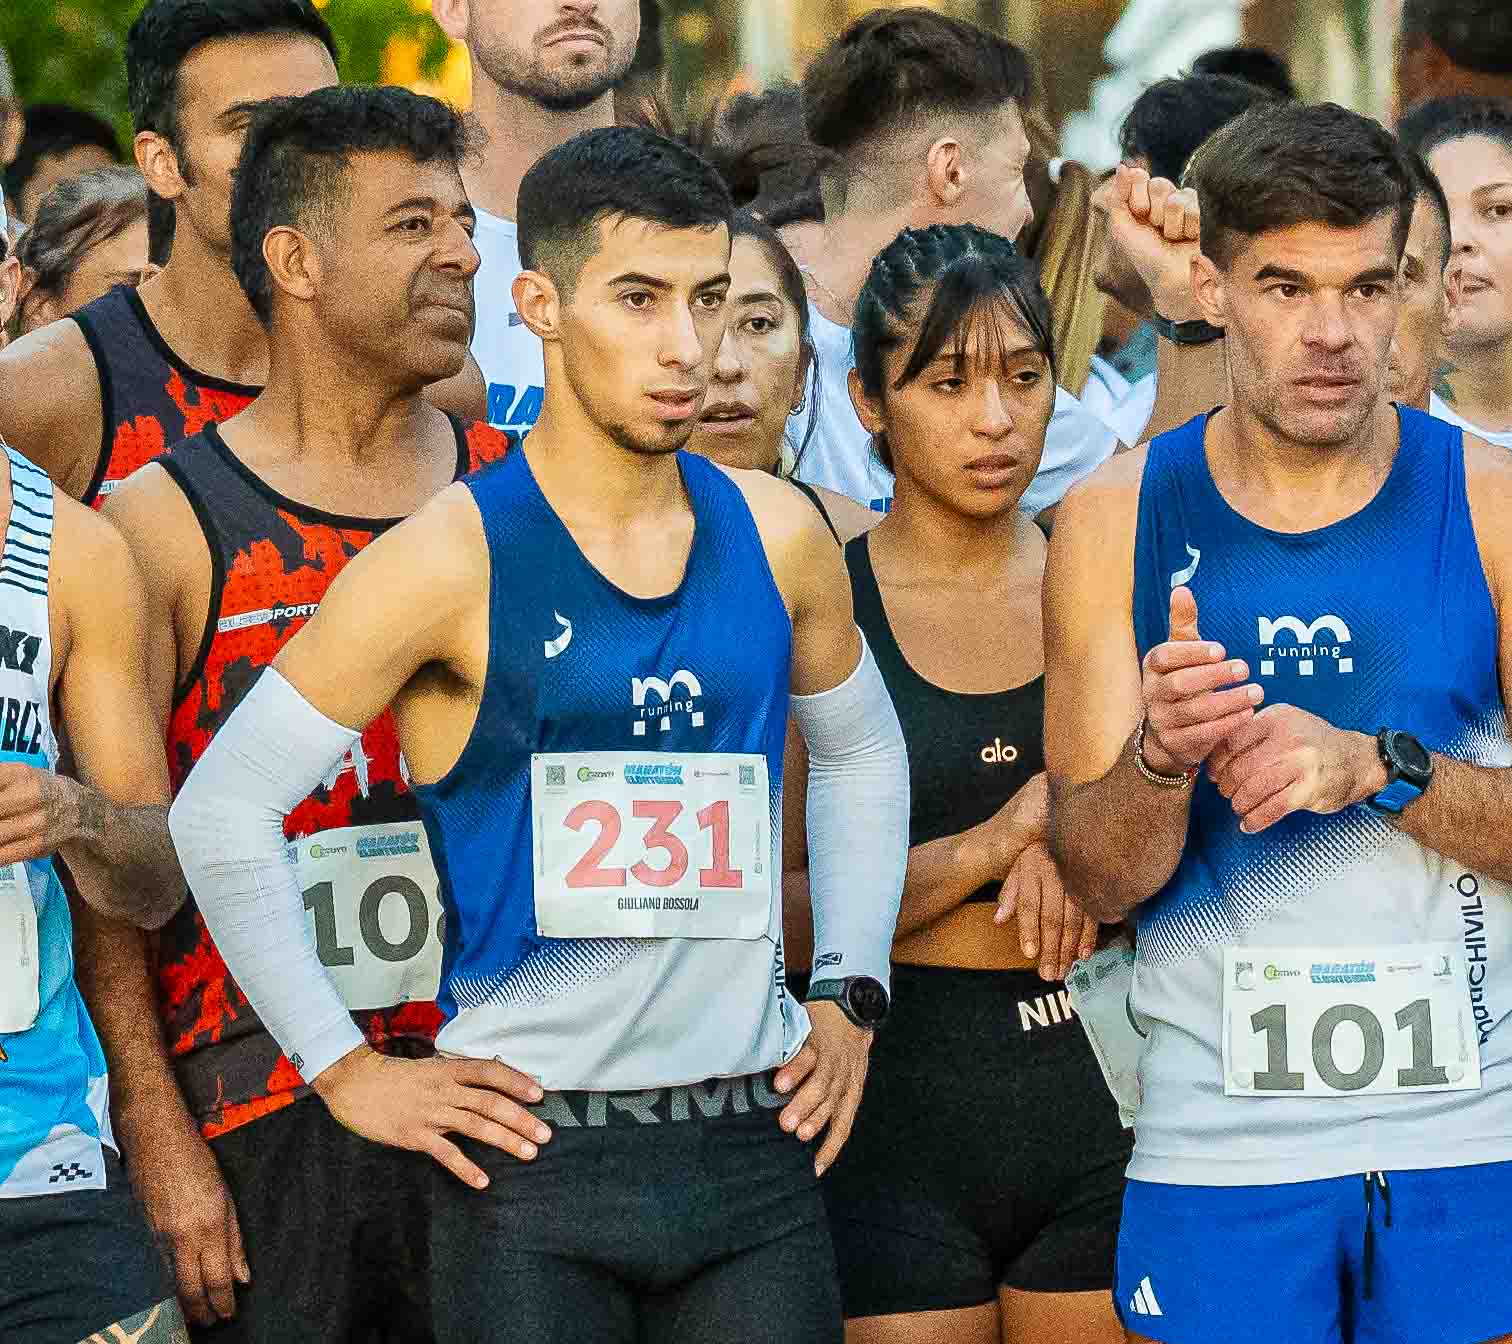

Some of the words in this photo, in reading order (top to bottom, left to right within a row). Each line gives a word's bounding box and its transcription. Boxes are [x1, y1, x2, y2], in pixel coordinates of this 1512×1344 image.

[1268, 644, 1341, 659] running
[640, 699, 693, 718] running
[981, 737, 1018, 763] alo
[564, 800, 742, 888] 231
[617, 897, 660, 910] GIULIANO
[302, 875, 447, 966] 10
[1250, 998, 1450, 1091] 101
